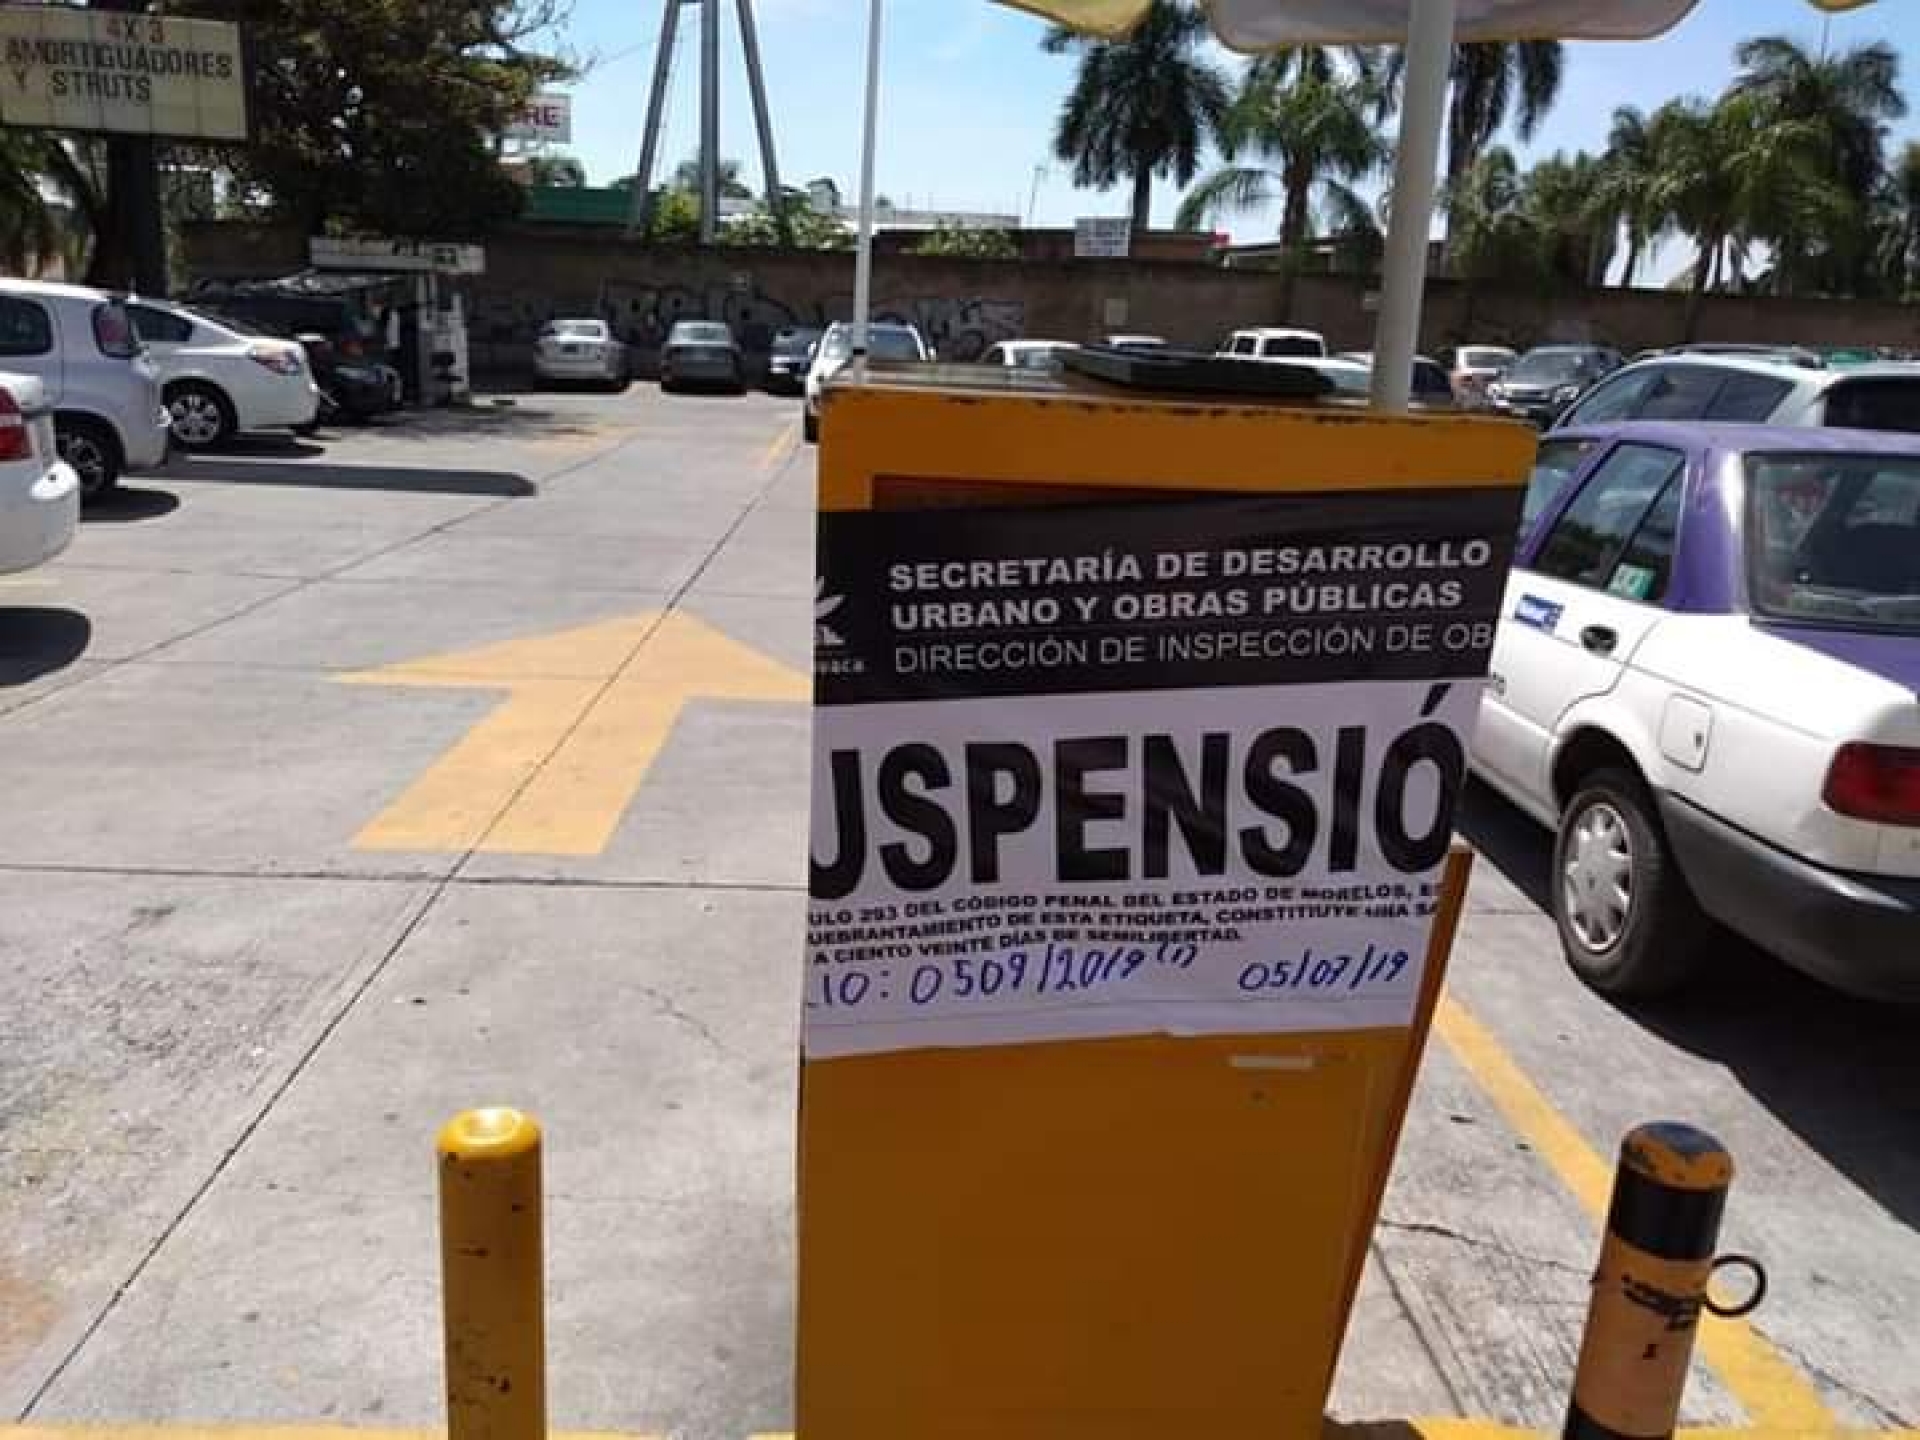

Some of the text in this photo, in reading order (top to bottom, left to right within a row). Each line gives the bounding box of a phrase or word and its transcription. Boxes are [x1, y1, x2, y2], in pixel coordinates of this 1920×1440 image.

[5, 37, 233, 78] AMORTIGUADORES
[12, 66, 151, 101] Y STRUTS
[889, 540, 1490, 591] SECRETARÍA DE DESARROLLO
[892, 580, 1462, 629] URBANO Y OBRAS PÚBLICAS
[895, 622, 1493, 673] DIRECCIÓN DE INSPECCIÓN DE OB
[809, 910, 853, 926] ULO
[904, 900, 945, 918] DEL
[1044, 894, 1117, 908] PENAL
[1123, 893, 1165, 908] DEL
[1173, 887, 1258, 905] ESTADO
[1265, 887, 1295, 900] DE
[1008, 912, 1035, 926] DE
[1041, 911, 1093, 926] ESTA
[813, 950, 829, 965] A
[835, 944, 912, 963] CIENTO
[919, 936, 993, 957] VEINTE
[1053, 930, 1080, 942] DE
